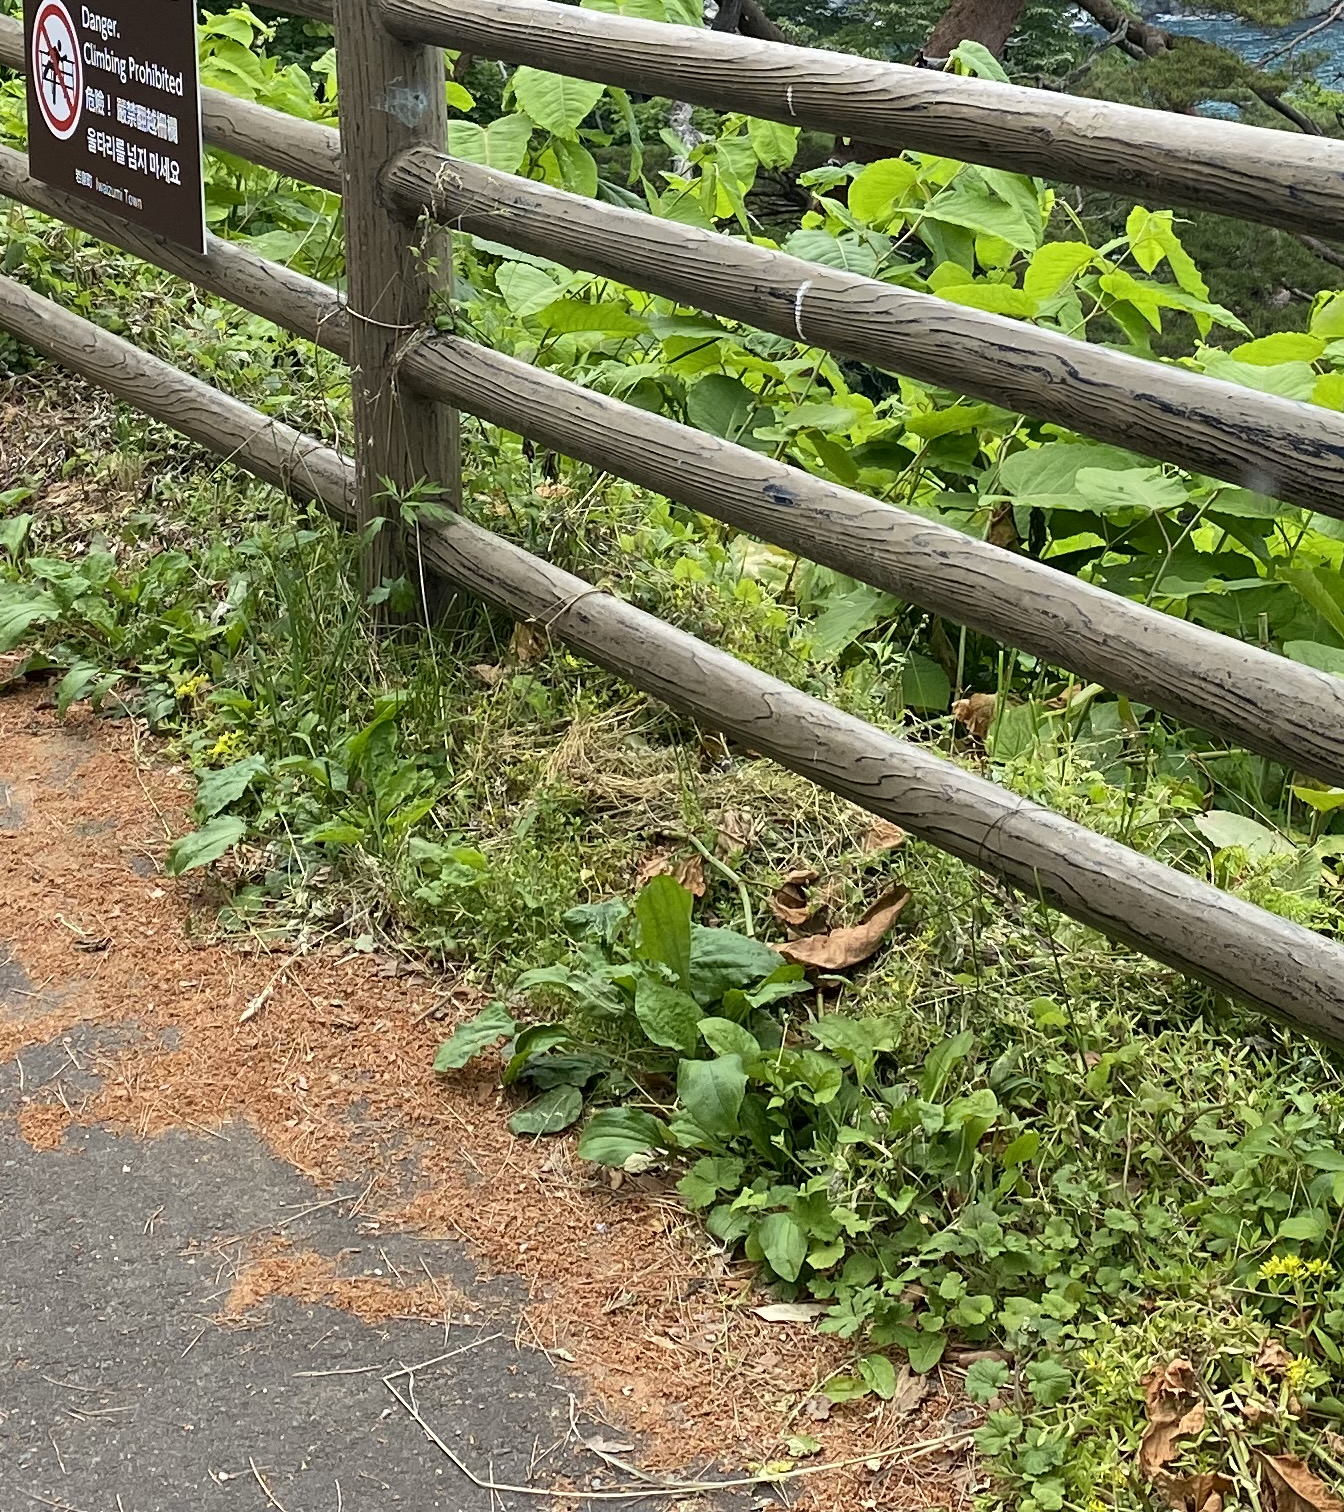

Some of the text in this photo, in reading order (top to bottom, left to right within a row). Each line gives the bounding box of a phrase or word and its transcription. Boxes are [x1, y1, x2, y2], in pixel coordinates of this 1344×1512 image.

[81, 5, 121, 41] Danger.
[83, 41, 184, 97] Climbing Prohibited
[86, 127, 182, 186] 울타리를 넘지 마세요
